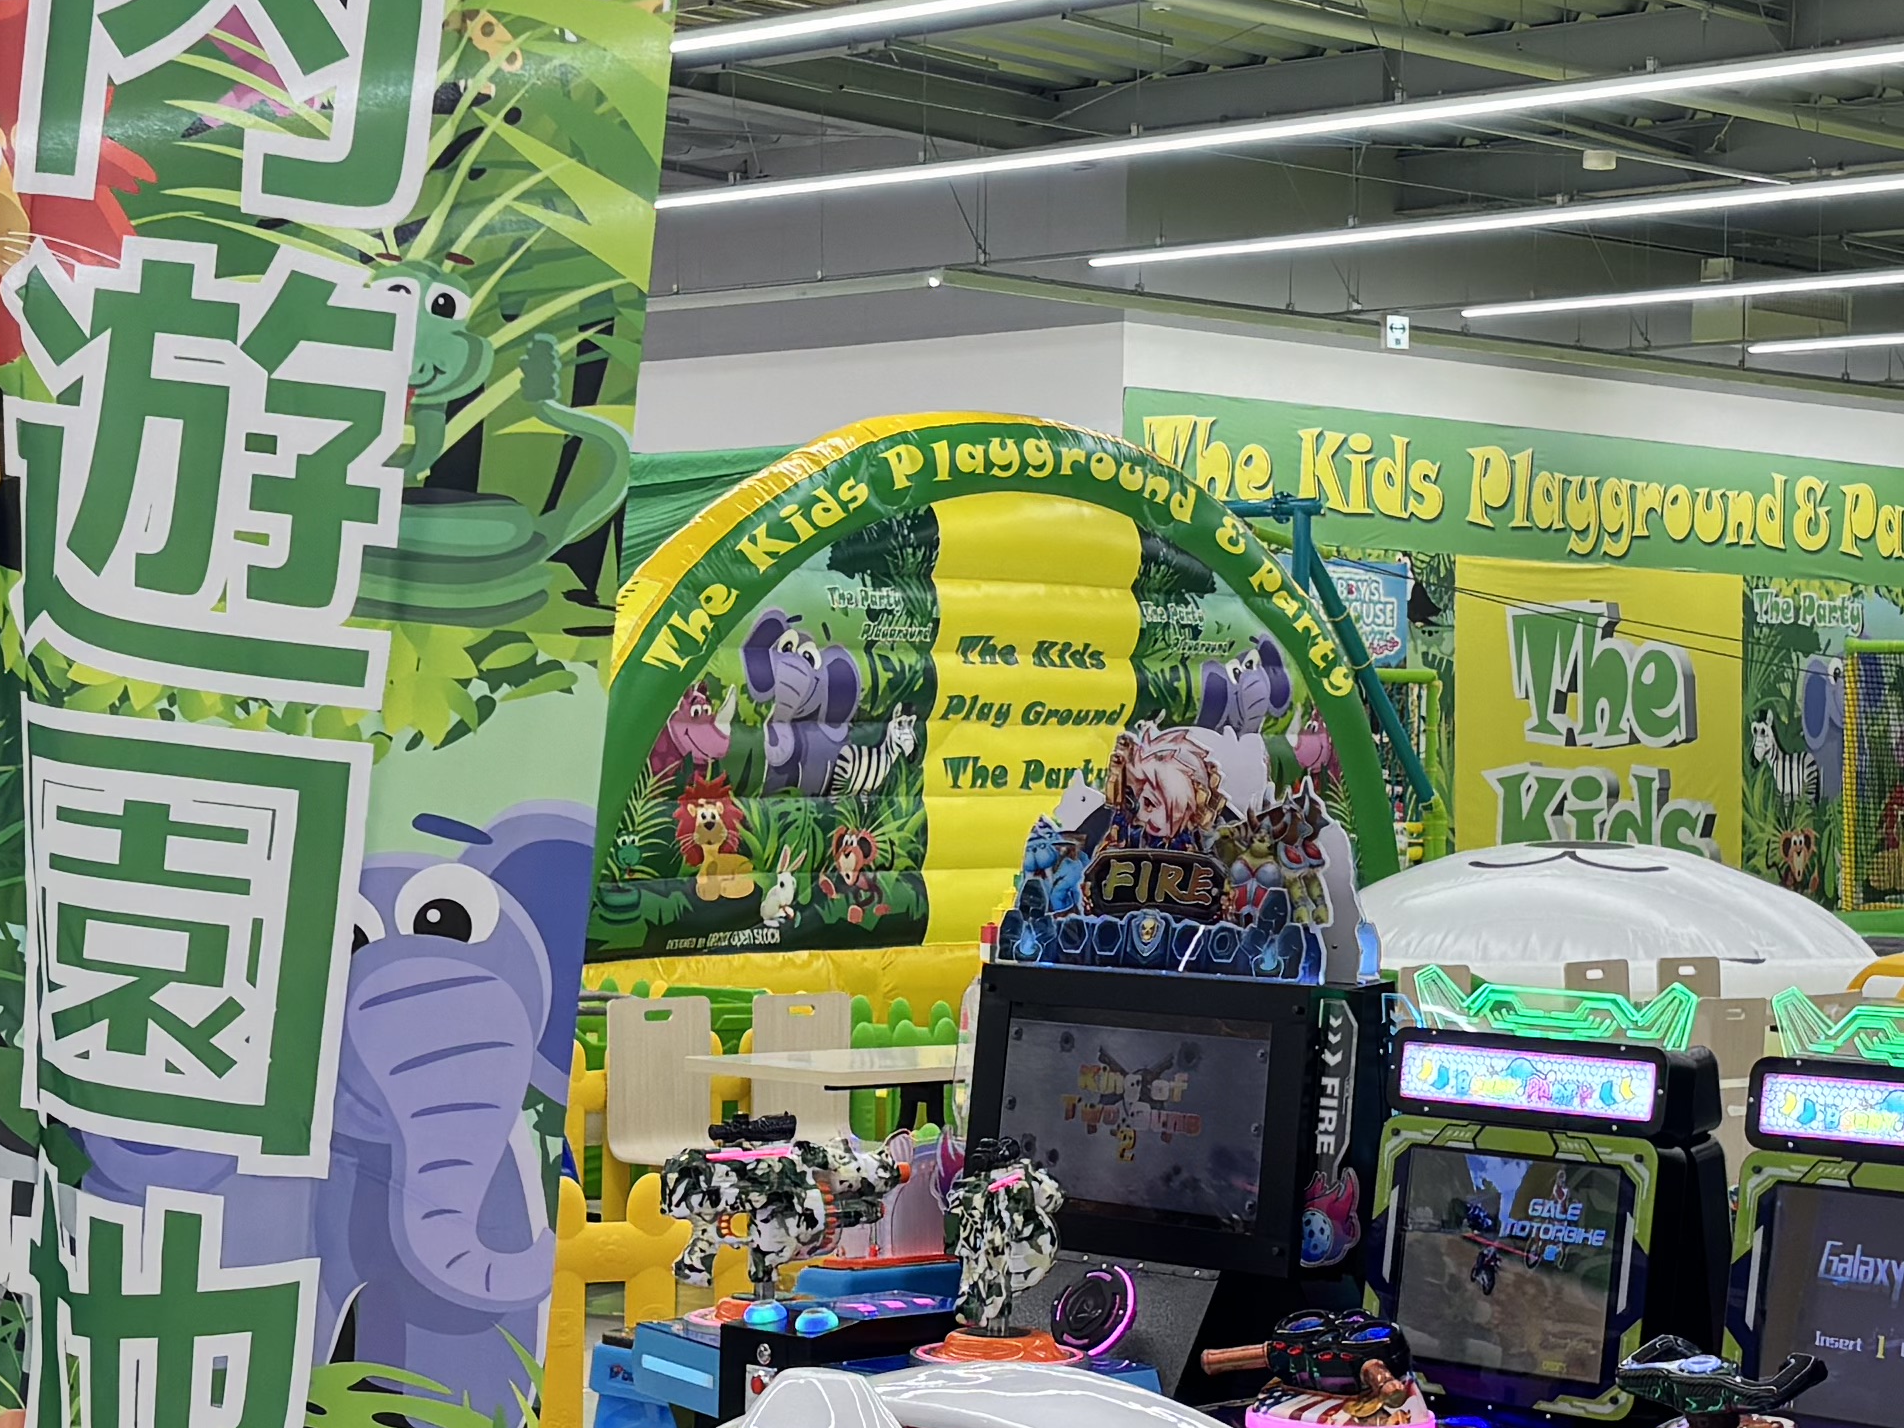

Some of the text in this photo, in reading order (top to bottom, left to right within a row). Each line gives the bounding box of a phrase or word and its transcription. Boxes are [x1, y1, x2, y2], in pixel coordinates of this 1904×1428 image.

[1144, 415, 1273, 501] The
[1296, 427, 1444, 521] Kids
[1467, 445, 1786, 556] Playground
[1793, 476, 1832, 552] &
[642, 436, 1354, 697] The Kids Playground & Party
[825, 585, 858, 610] The
[1753, 588, 1864, 635] The Party
[955, 635, 1107, 671] The Kids
[1504, 600, 1698, 750] The
[938, 693, 1127, 728] Play Ground
[942, 756, 1008, 791] The
[1482, 762, 1715, 859] Kids
[1100, 857, 1216, 907] FIRE
[1314, 1076, 1343, 1157] FIRE
[1528, 1197, 1584, 1222] GALE
[1499, 1217, 1606, 1249] MOTORBIKE
[1815, 1331, 1863, 1354] Insert
[1875, 1334, 1886, 1360] 1
